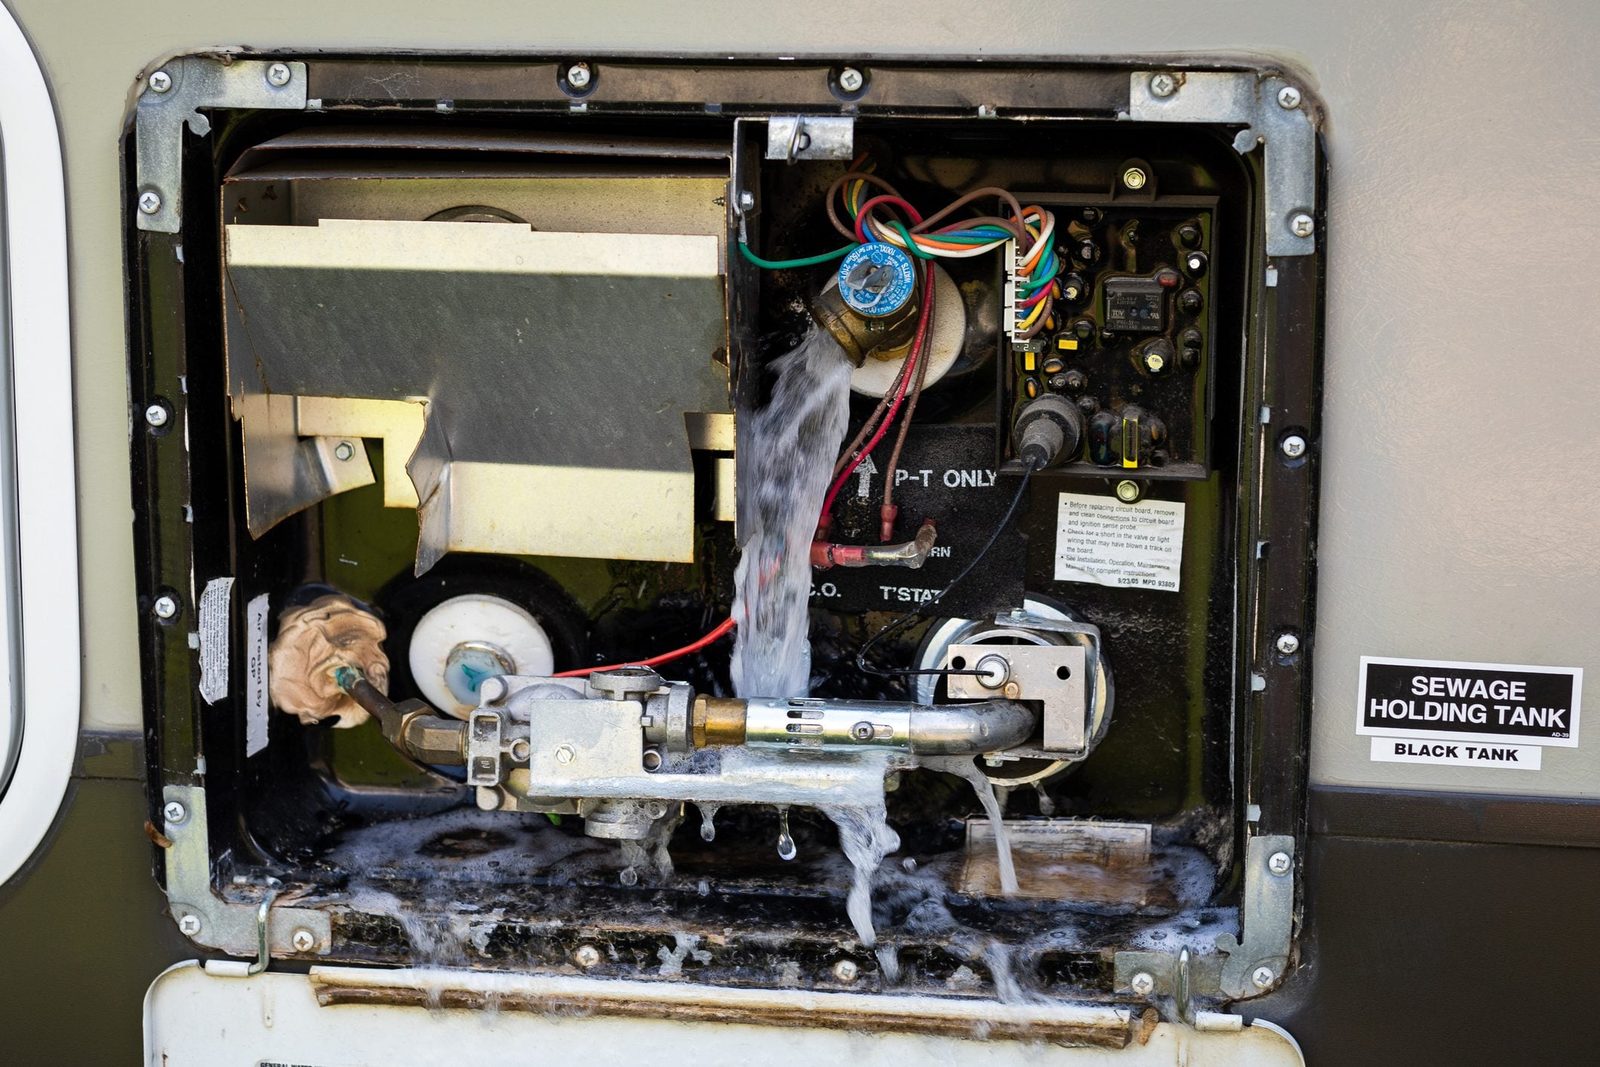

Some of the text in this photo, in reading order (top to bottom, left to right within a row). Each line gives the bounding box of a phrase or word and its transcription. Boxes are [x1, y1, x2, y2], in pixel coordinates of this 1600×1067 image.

[901, 262, 912, 283] WATTS
[895, 469, 997, 488] P-T ONLY
[1070, 501, 1088, 510] Before
[1089, 503, 1114, 512] replacing
[1080, 520, 1100, 528] ignition
[1096, 514, 1130, 522] connections
[1149, 544, 1163, 552] track
[1066, 563, 1085, 571] Manual
[1096, 567, 1120, 575] complete
[879, 585, 943, 604] T'STAT
[250, 656, 256, 679] GP
[256, 688, 262, 708] By
[1411, 676, 1527, 701] SEWAGE
[1370, 698, 1567, 729] HOLDING TANK
[1394, 742, 1519, 762] BLACK TANK
